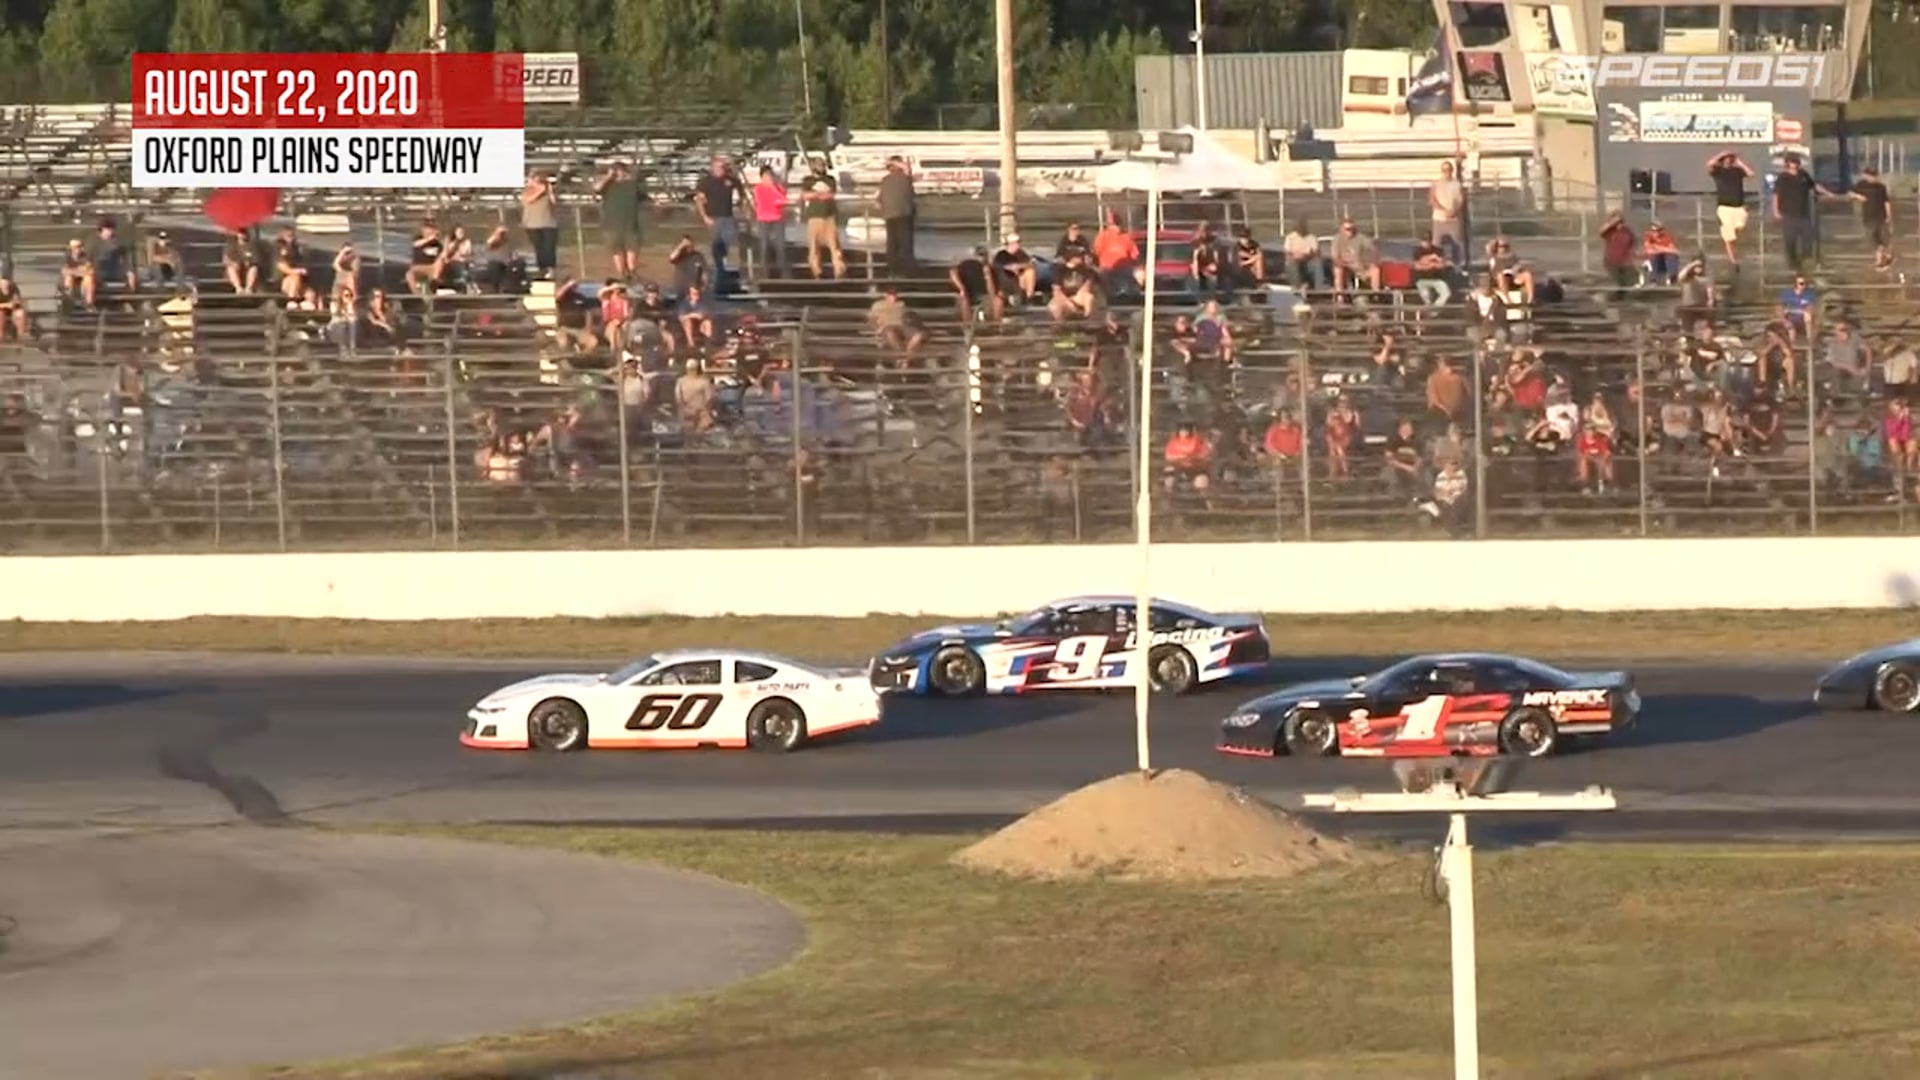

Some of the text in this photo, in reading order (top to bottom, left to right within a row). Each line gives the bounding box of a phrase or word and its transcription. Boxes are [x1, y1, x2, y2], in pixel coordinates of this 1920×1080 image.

[624, 693, 724, 731] 60
[1522, 689, 1608, 706] MAVERICK
[1395, 694, 1448, 741] 1
